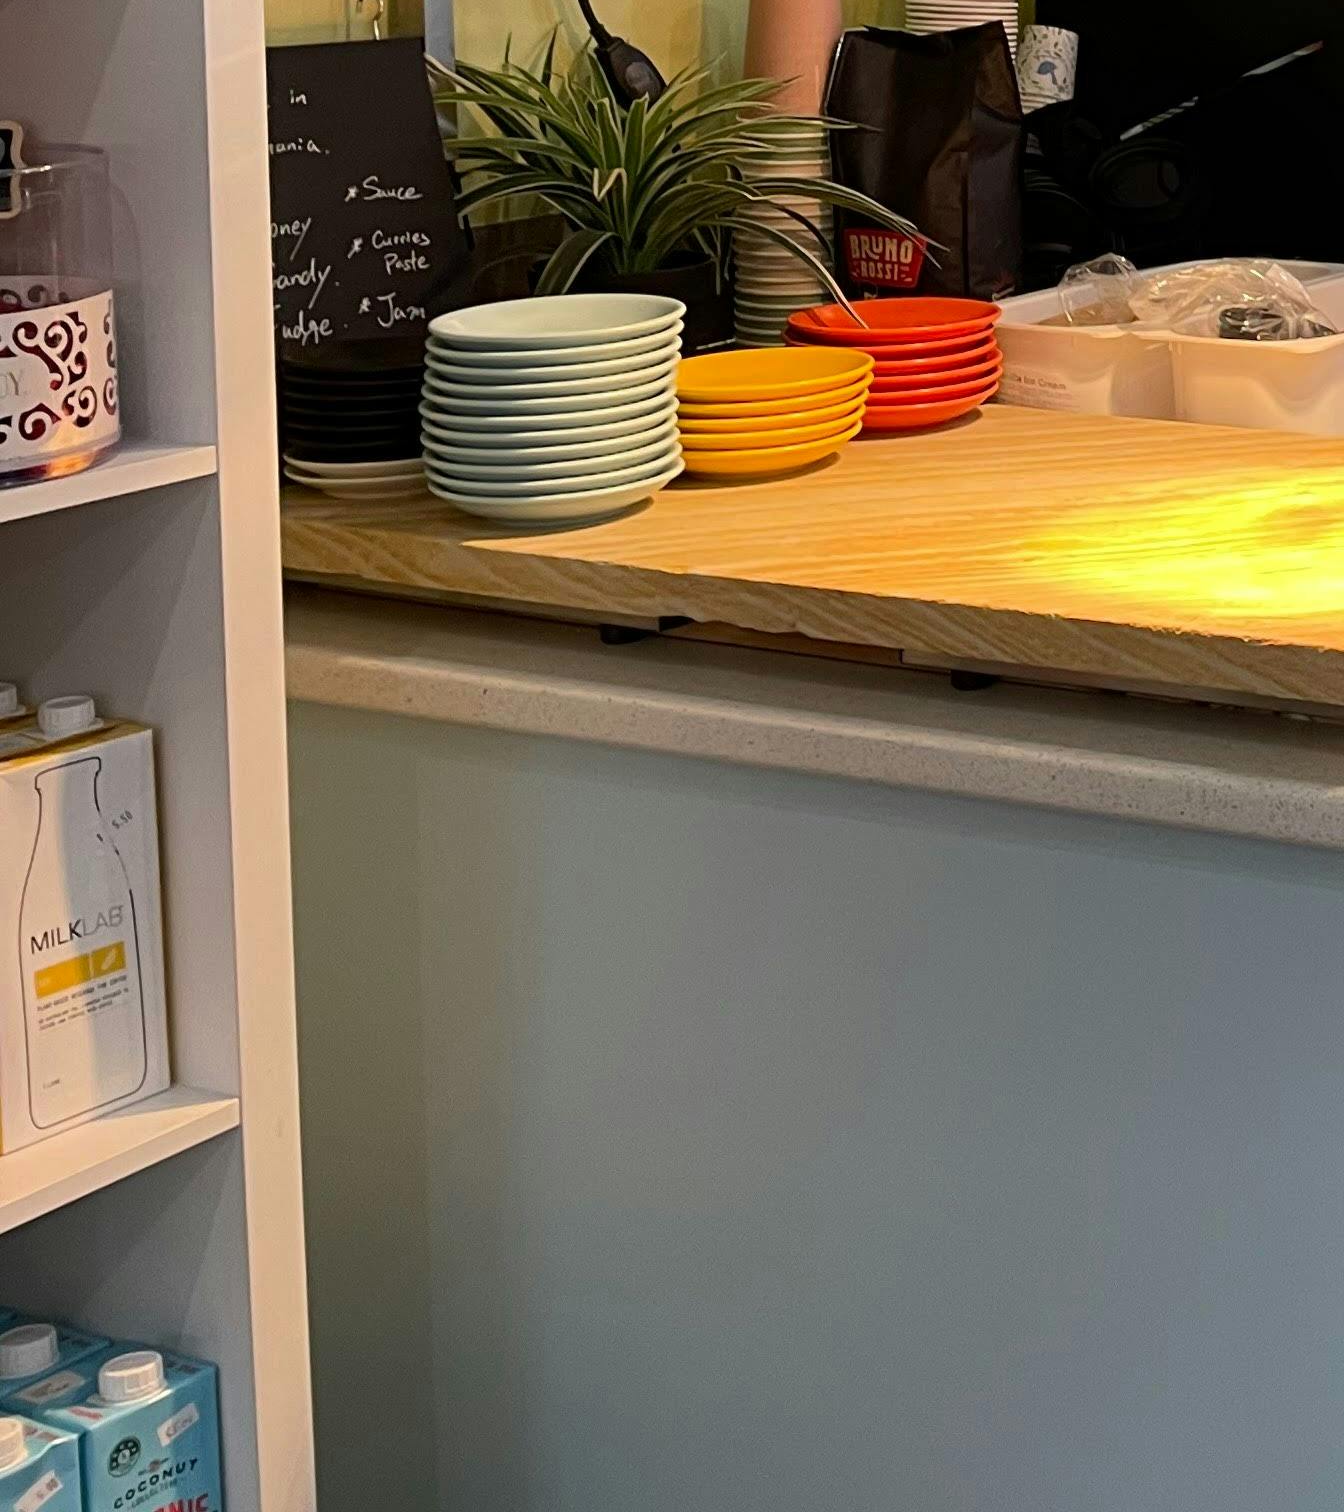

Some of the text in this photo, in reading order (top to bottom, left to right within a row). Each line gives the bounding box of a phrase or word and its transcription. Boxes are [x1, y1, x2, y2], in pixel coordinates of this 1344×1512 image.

[289, 89, 307, 105] in
[269, 138, 330, 155] ania.
[363, 176, 423, 200] Sauce
[270, 217, 311, 260] oney
[849, 234, 914, 264] BRUNO
[384, 250, 430, 275] Paste
[861, 261, 899, 281] ROSSI
[273, 257, 340, 309] andy.
[376, 292, 426, 328] Jam
[277, 309, 348, 346] udge.
[30, 905, 124, 955] MILKLAB
[113, 1458, 198, 1509] COCONUT
